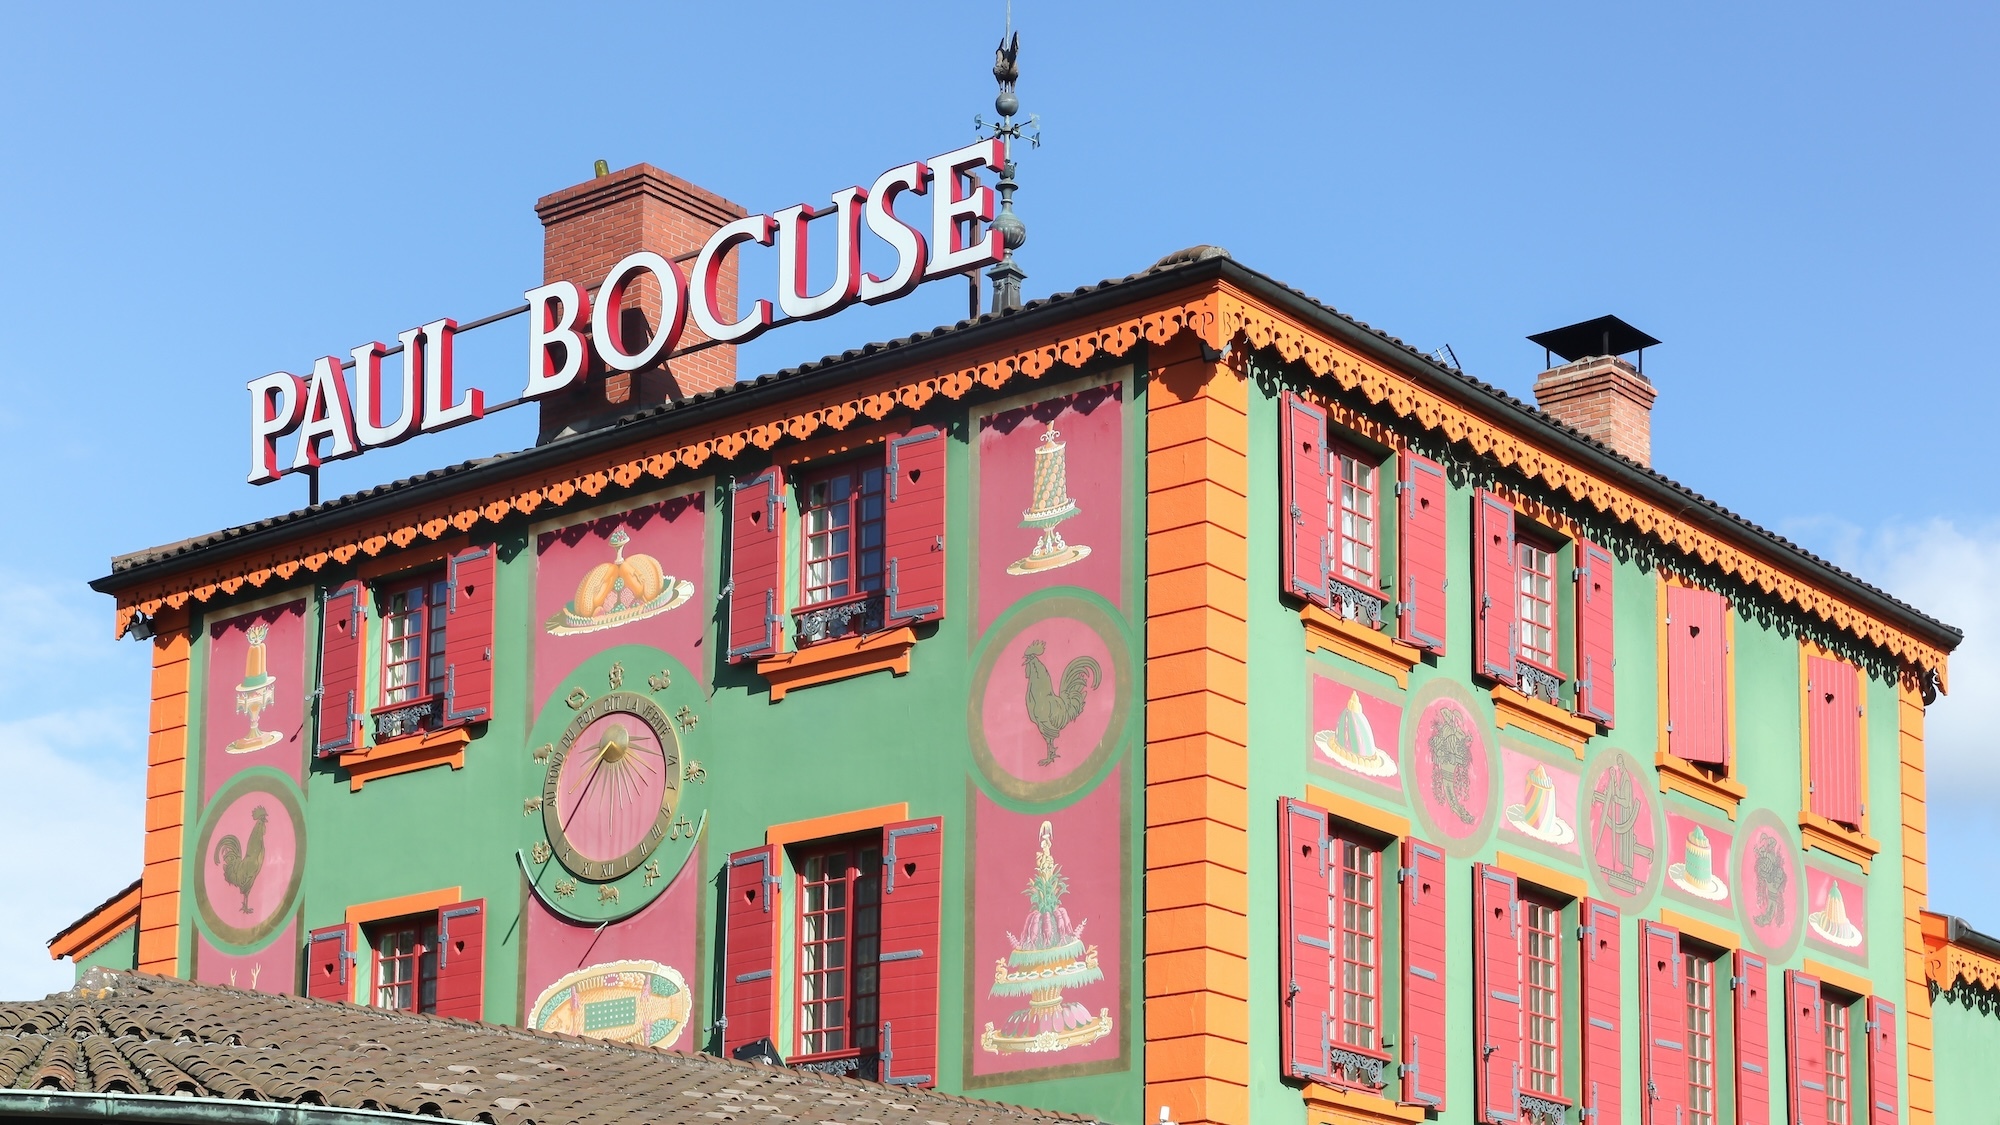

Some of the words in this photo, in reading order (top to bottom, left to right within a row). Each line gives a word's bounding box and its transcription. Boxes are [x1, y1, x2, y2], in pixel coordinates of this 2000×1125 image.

[246, 317, 484, 486] PAUL
[522, 138, 1004, 401] BOCUSE
[626, 697, 639, 712] LA
[561, 728, 577, 748] DU
[548, 751, 565, 785] FOND
[546, 791, 557, 808] AU
[600, 863, 614, 877] XII
